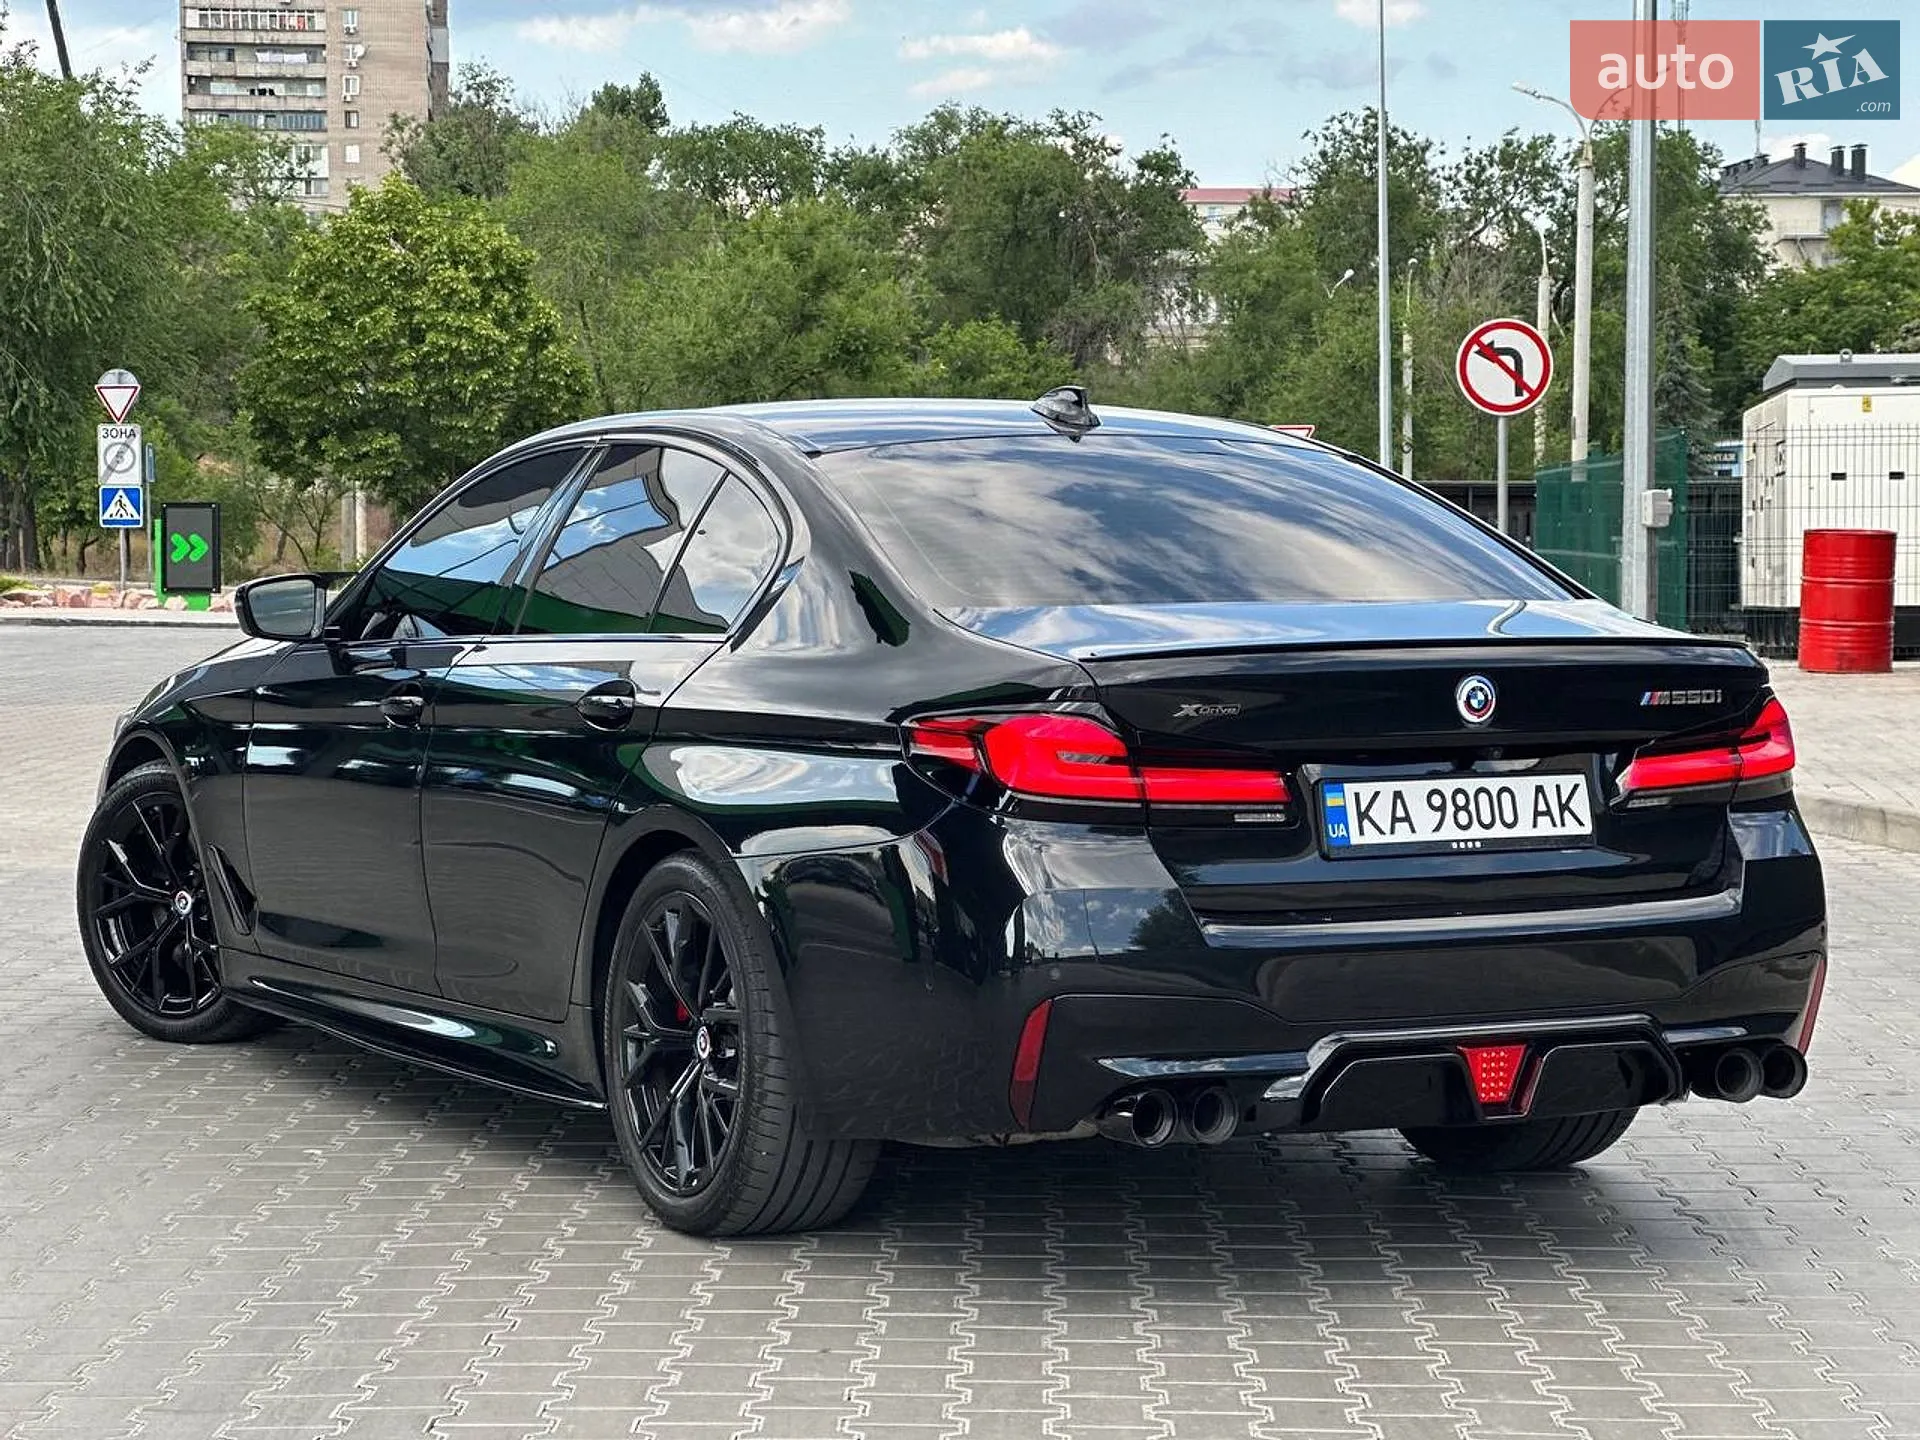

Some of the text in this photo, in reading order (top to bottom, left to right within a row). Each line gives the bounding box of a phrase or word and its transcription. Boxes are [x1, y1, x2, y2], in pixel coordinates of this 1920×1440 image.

[102, 427, 136, 439] ЗОНА
[1353, 783, 1586, 836] KA 9800 AK
[1328, 823, 1348, 838] UA
